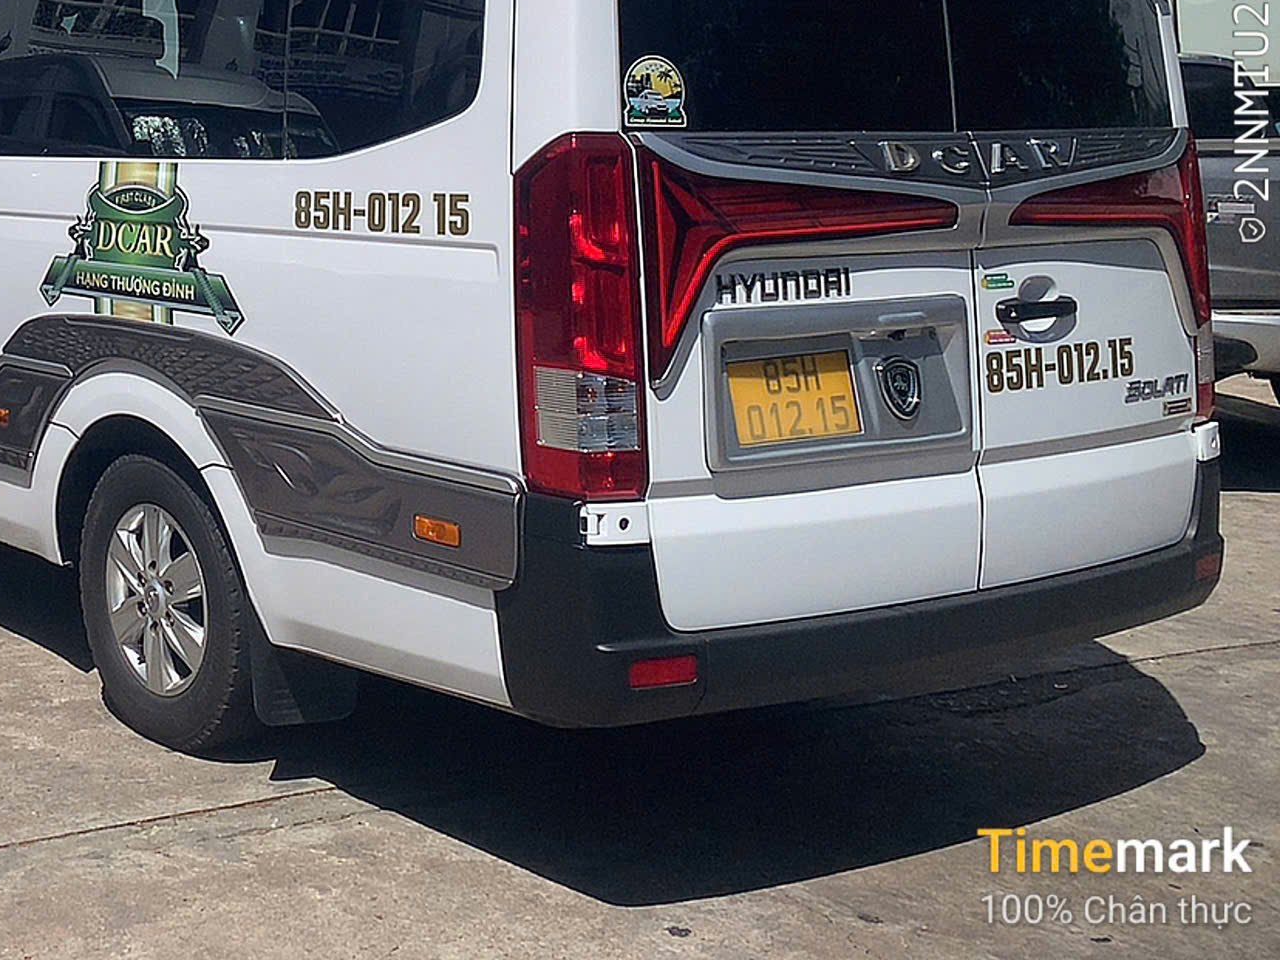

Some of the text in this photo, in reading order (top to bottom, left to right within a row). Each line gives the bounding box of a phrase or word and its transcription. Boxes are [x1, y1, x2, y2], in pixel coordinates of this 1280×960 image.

[878, 137, 1072, 174] DCAR
[294, 190, 470, 236] 85H-012 15
[96, 219, 174, 257] DCAR
[76, 271, 108, 290] HẠNG
[111, 274, 160, 296] THƯỢNG
[717, 268, 851, 304] HYUNDAI
[764, 355, 821, 394] 85H
[986, 338, 1135, 393] 85H-012.15
[746, 394, 850, 441] 012.15
